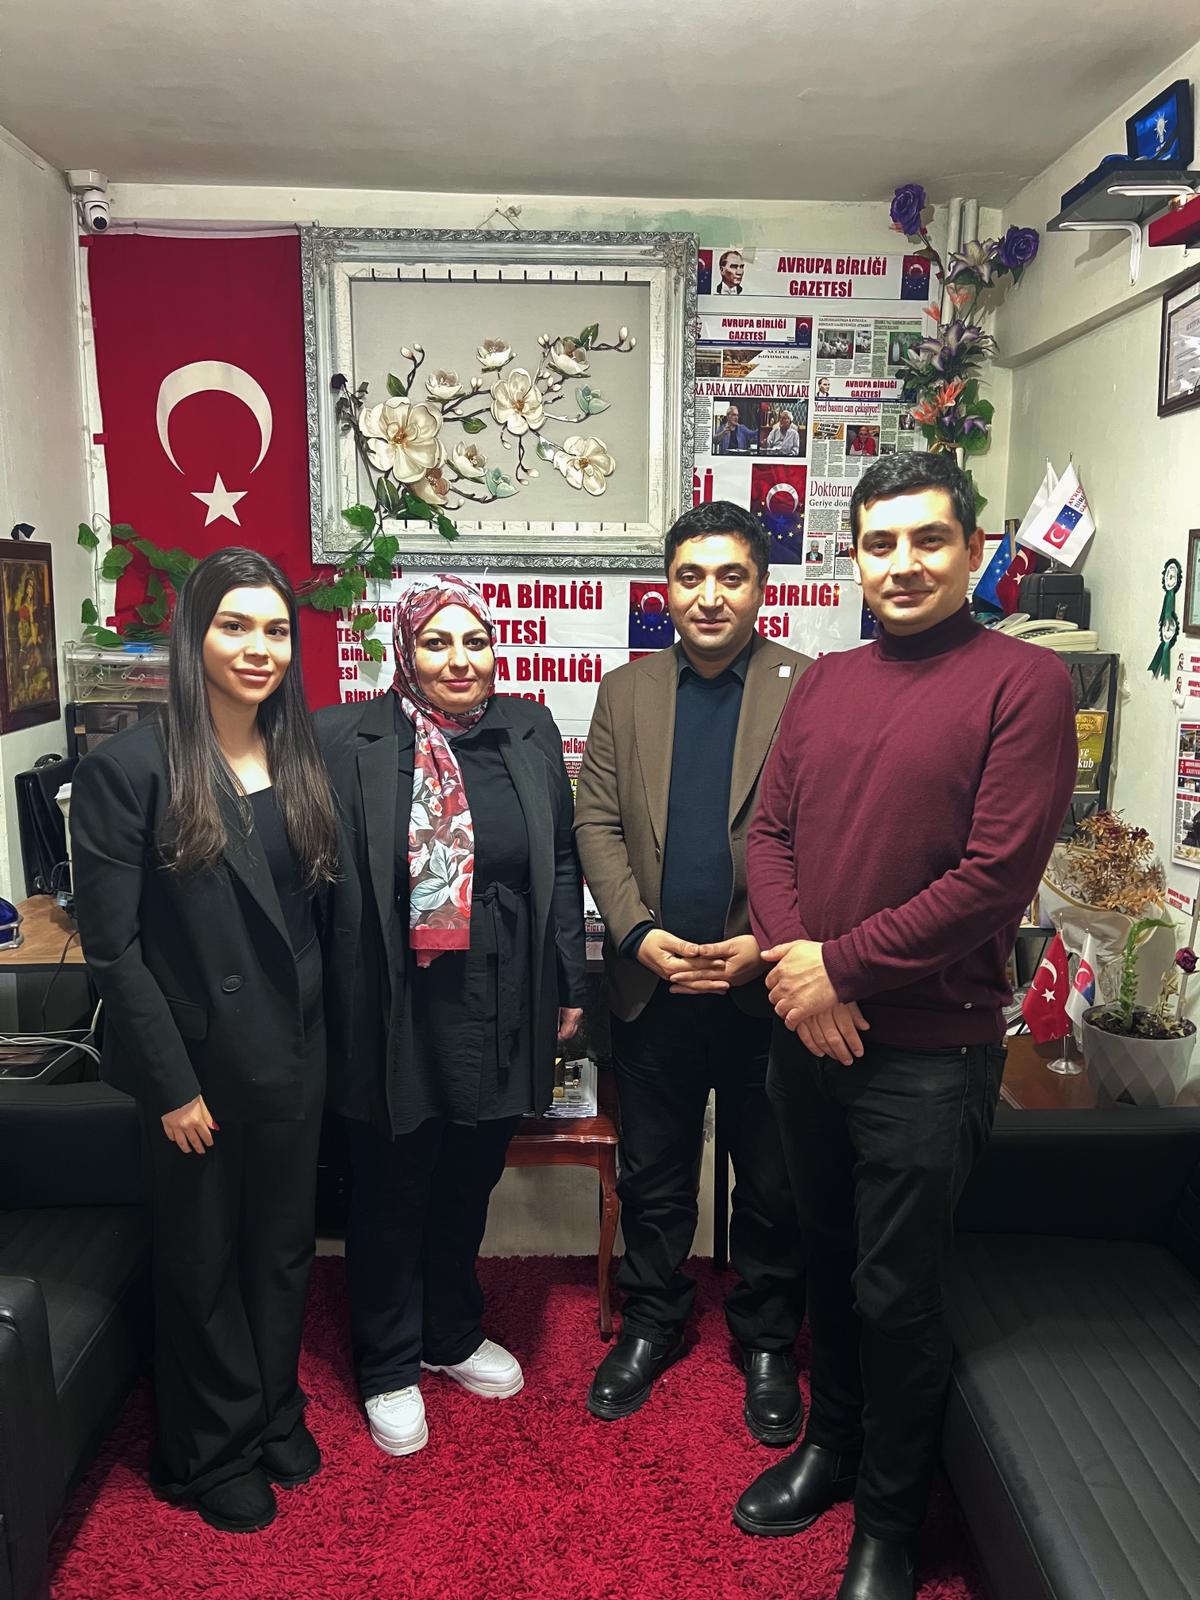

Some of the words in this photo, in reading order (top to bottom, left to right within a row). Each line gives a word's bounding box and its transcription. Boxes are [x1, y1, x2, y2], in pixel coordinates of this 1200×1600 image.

[777, 256, 834, 275] AVRUPA
[835, 256, 887, 276] BİRLİĞİ
[789, 279, 853, 298] GAZETESİ
[721, 318, 754, 329] AVRUPA
[756, 318, 787, 330] BİRLİĞİ
[728, 331, 767, 341] GAZETESİ
[705, 383, 727, 396] PARA
[727, 383, 775, 397] AKLAMININ
[775, 384, 810, 398] YOLLARI
[845, 380, 872, 389] AVRUPA
[872, 380, 897, 389] BİRLİĞİ
[850, 390, 881, 398] GAZETESİ
[814, 402, 828, 412] Yerel
[828, 402, 844, 413] basını
[844, 404, 854, 413] can
[809, 480, 853, 497] Doktorun
[808, 499, 833, 508] Geriye
[475, 583, 512, 609] PA
[517, 579, 603, 610] BİRLİĞİ
[764, 583, 841, 607] BİRLİĞİ
[493, 616, 547, 645] TESİ
[516, 652, 603, 684] BİRLİĞİ
